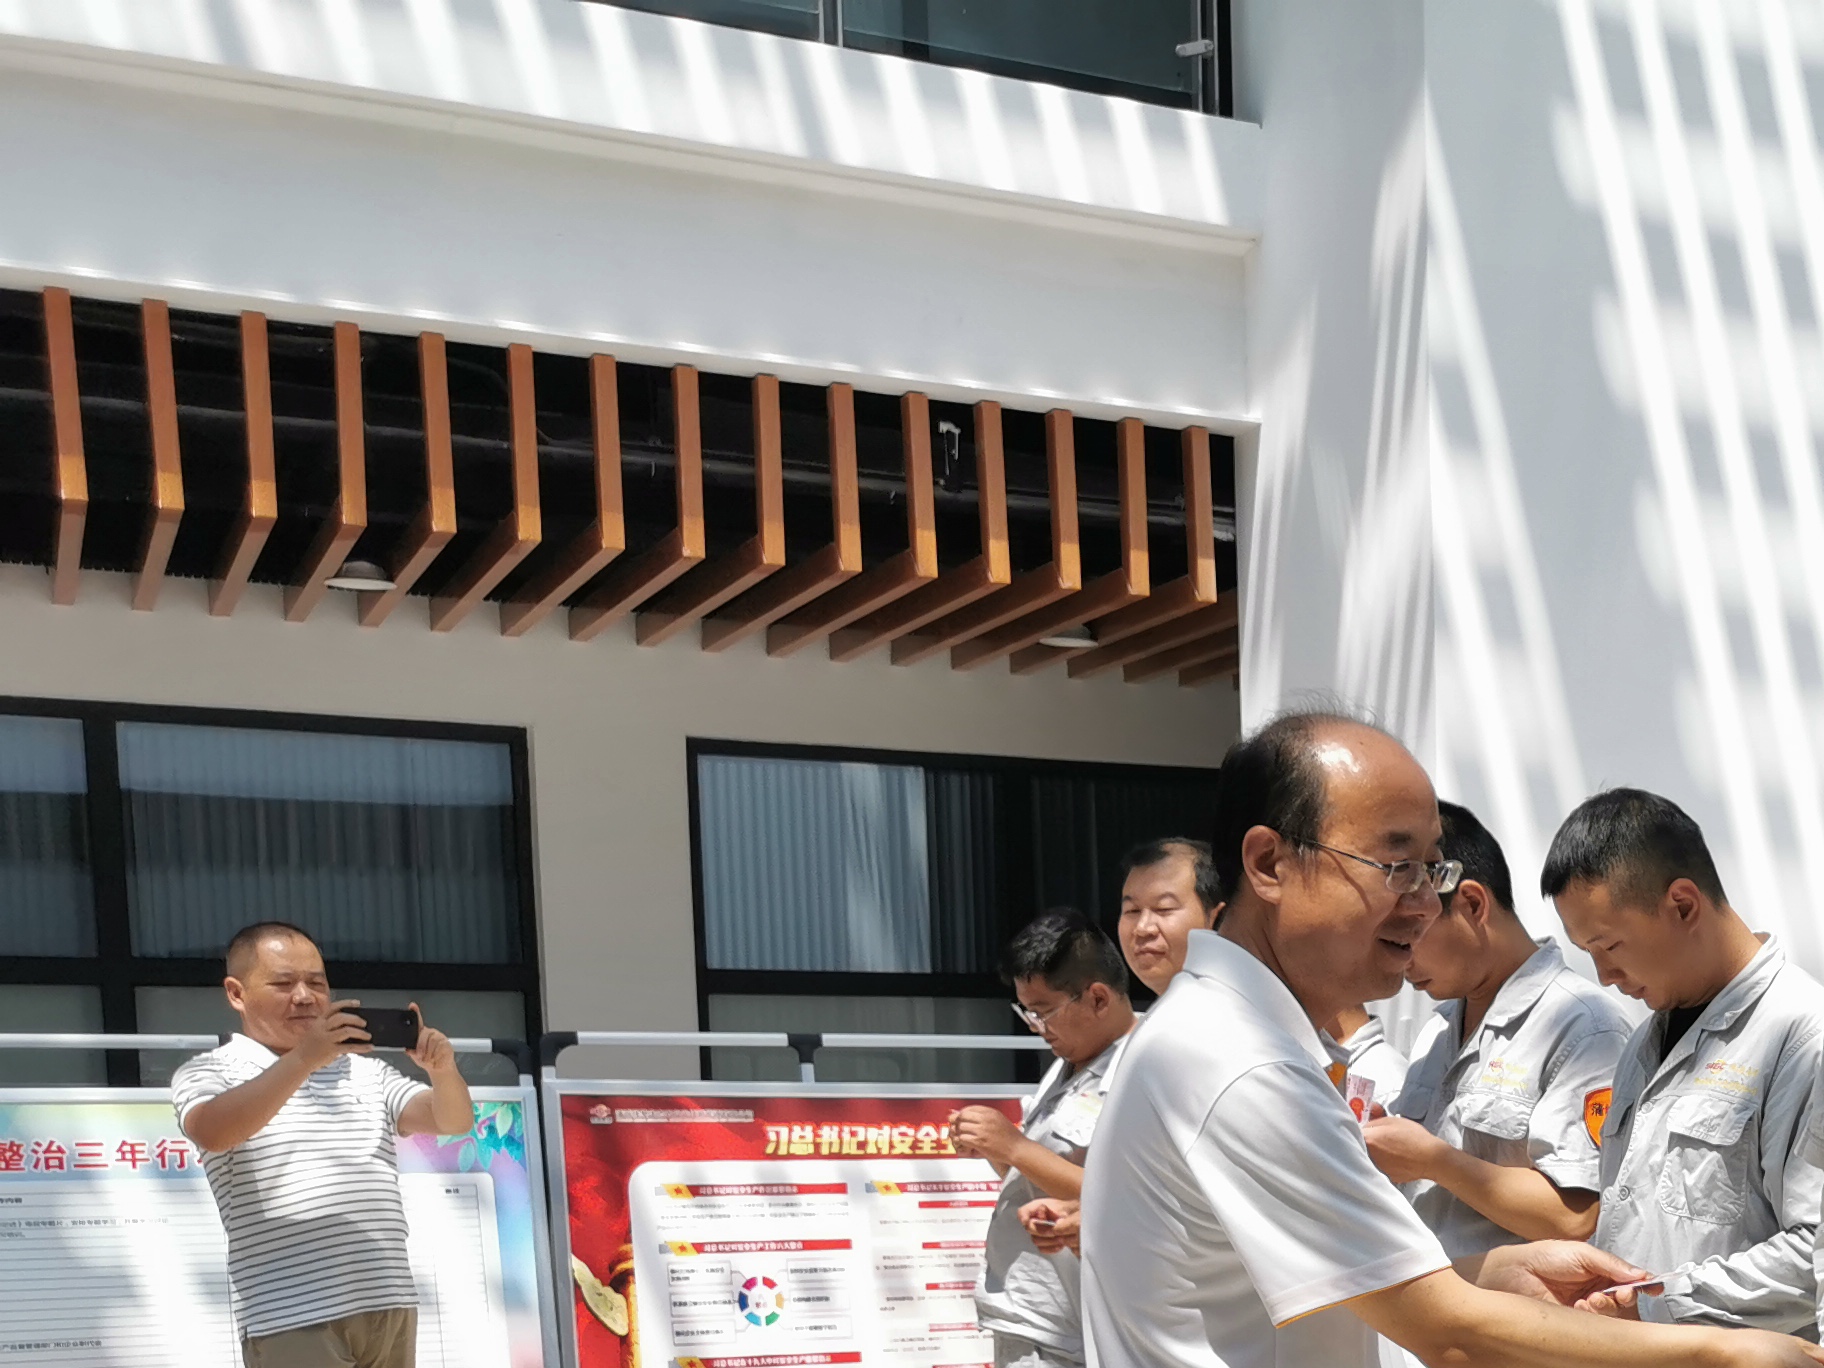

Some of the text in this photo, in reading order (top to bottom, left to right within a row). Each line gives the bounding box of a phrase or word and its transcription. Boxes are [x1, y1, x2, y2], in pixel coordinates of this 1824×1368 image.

[0, 1139, 203, 1172] 整治三年行
